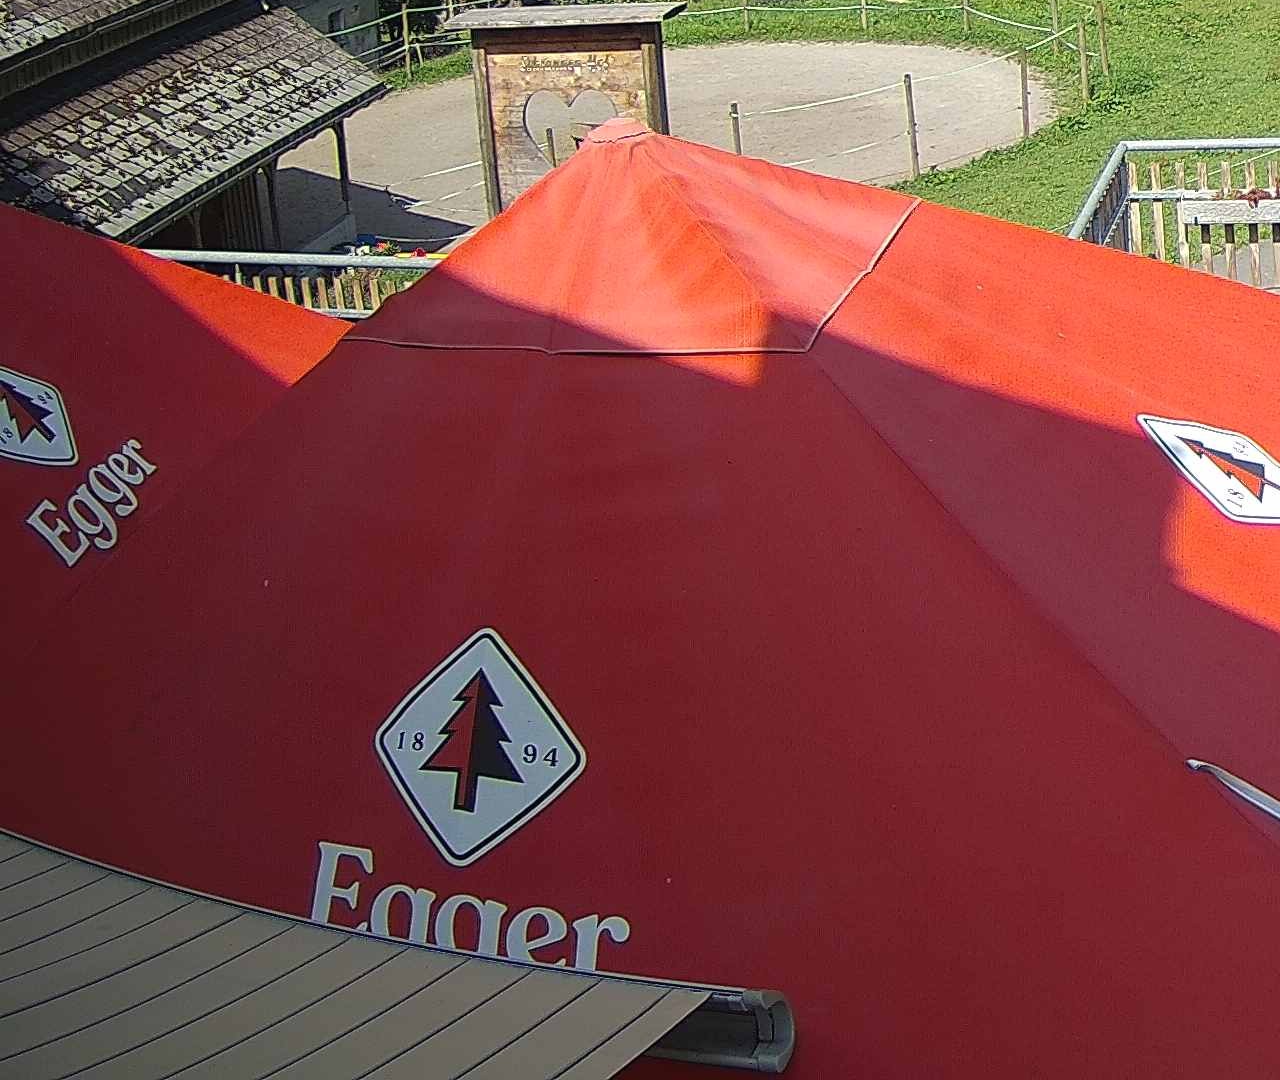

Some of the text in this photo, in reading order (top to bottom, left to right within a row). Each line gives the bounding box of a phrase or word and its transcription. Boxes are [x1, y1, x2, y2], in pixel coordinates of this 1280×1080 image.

[25, 438, 158, 568] Egger
[397, 731, 559, 767] 18 94
